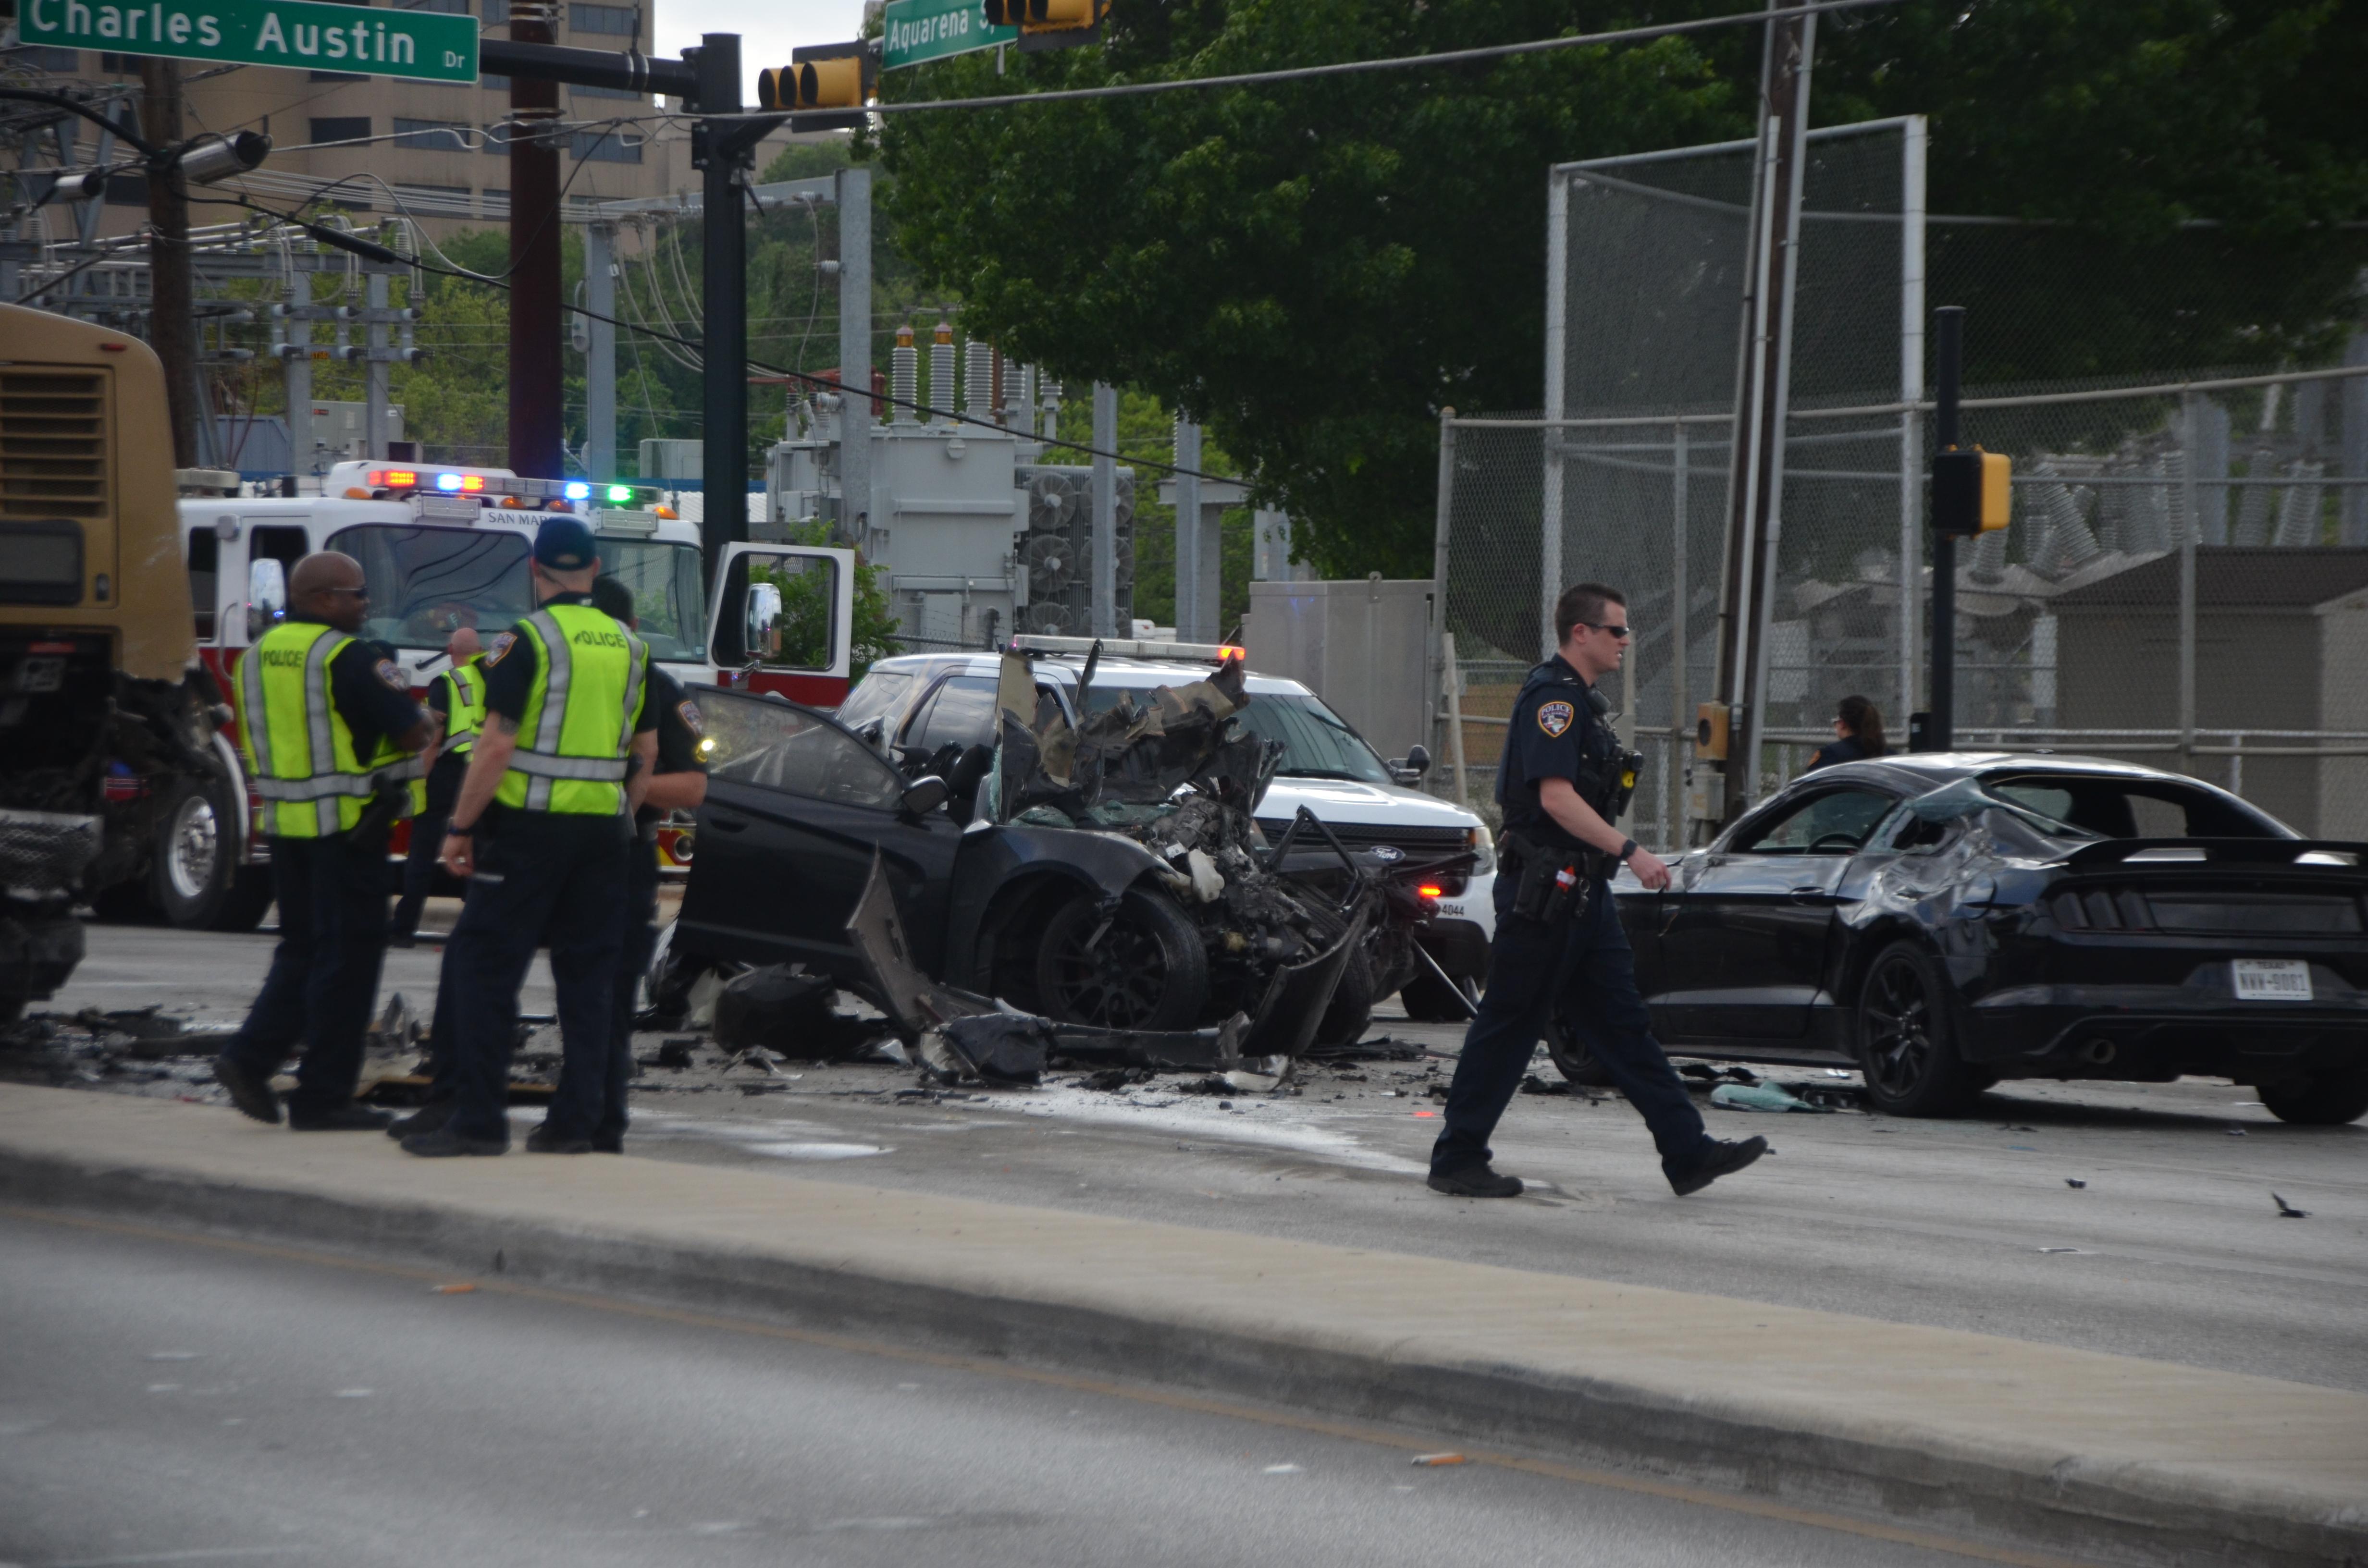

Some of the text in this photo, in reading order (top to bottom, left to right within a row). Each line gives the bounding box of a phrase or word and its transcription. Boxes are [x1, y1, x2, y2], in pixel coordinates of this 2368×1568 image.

[30, 0, 465, 68] Charles Austin Dr
[888, 8, 969, 54] Aquarena
[488, 511, 515, 524] SAN
[263, 649, 305, 668] POLICE
[1542, 704, 1571, 716] POLICE
[1376, 847, 1397, 859] Ford
[1442, 904, 1465, 916] 4044
[2257, 960, 2286, 969] TEXAS
